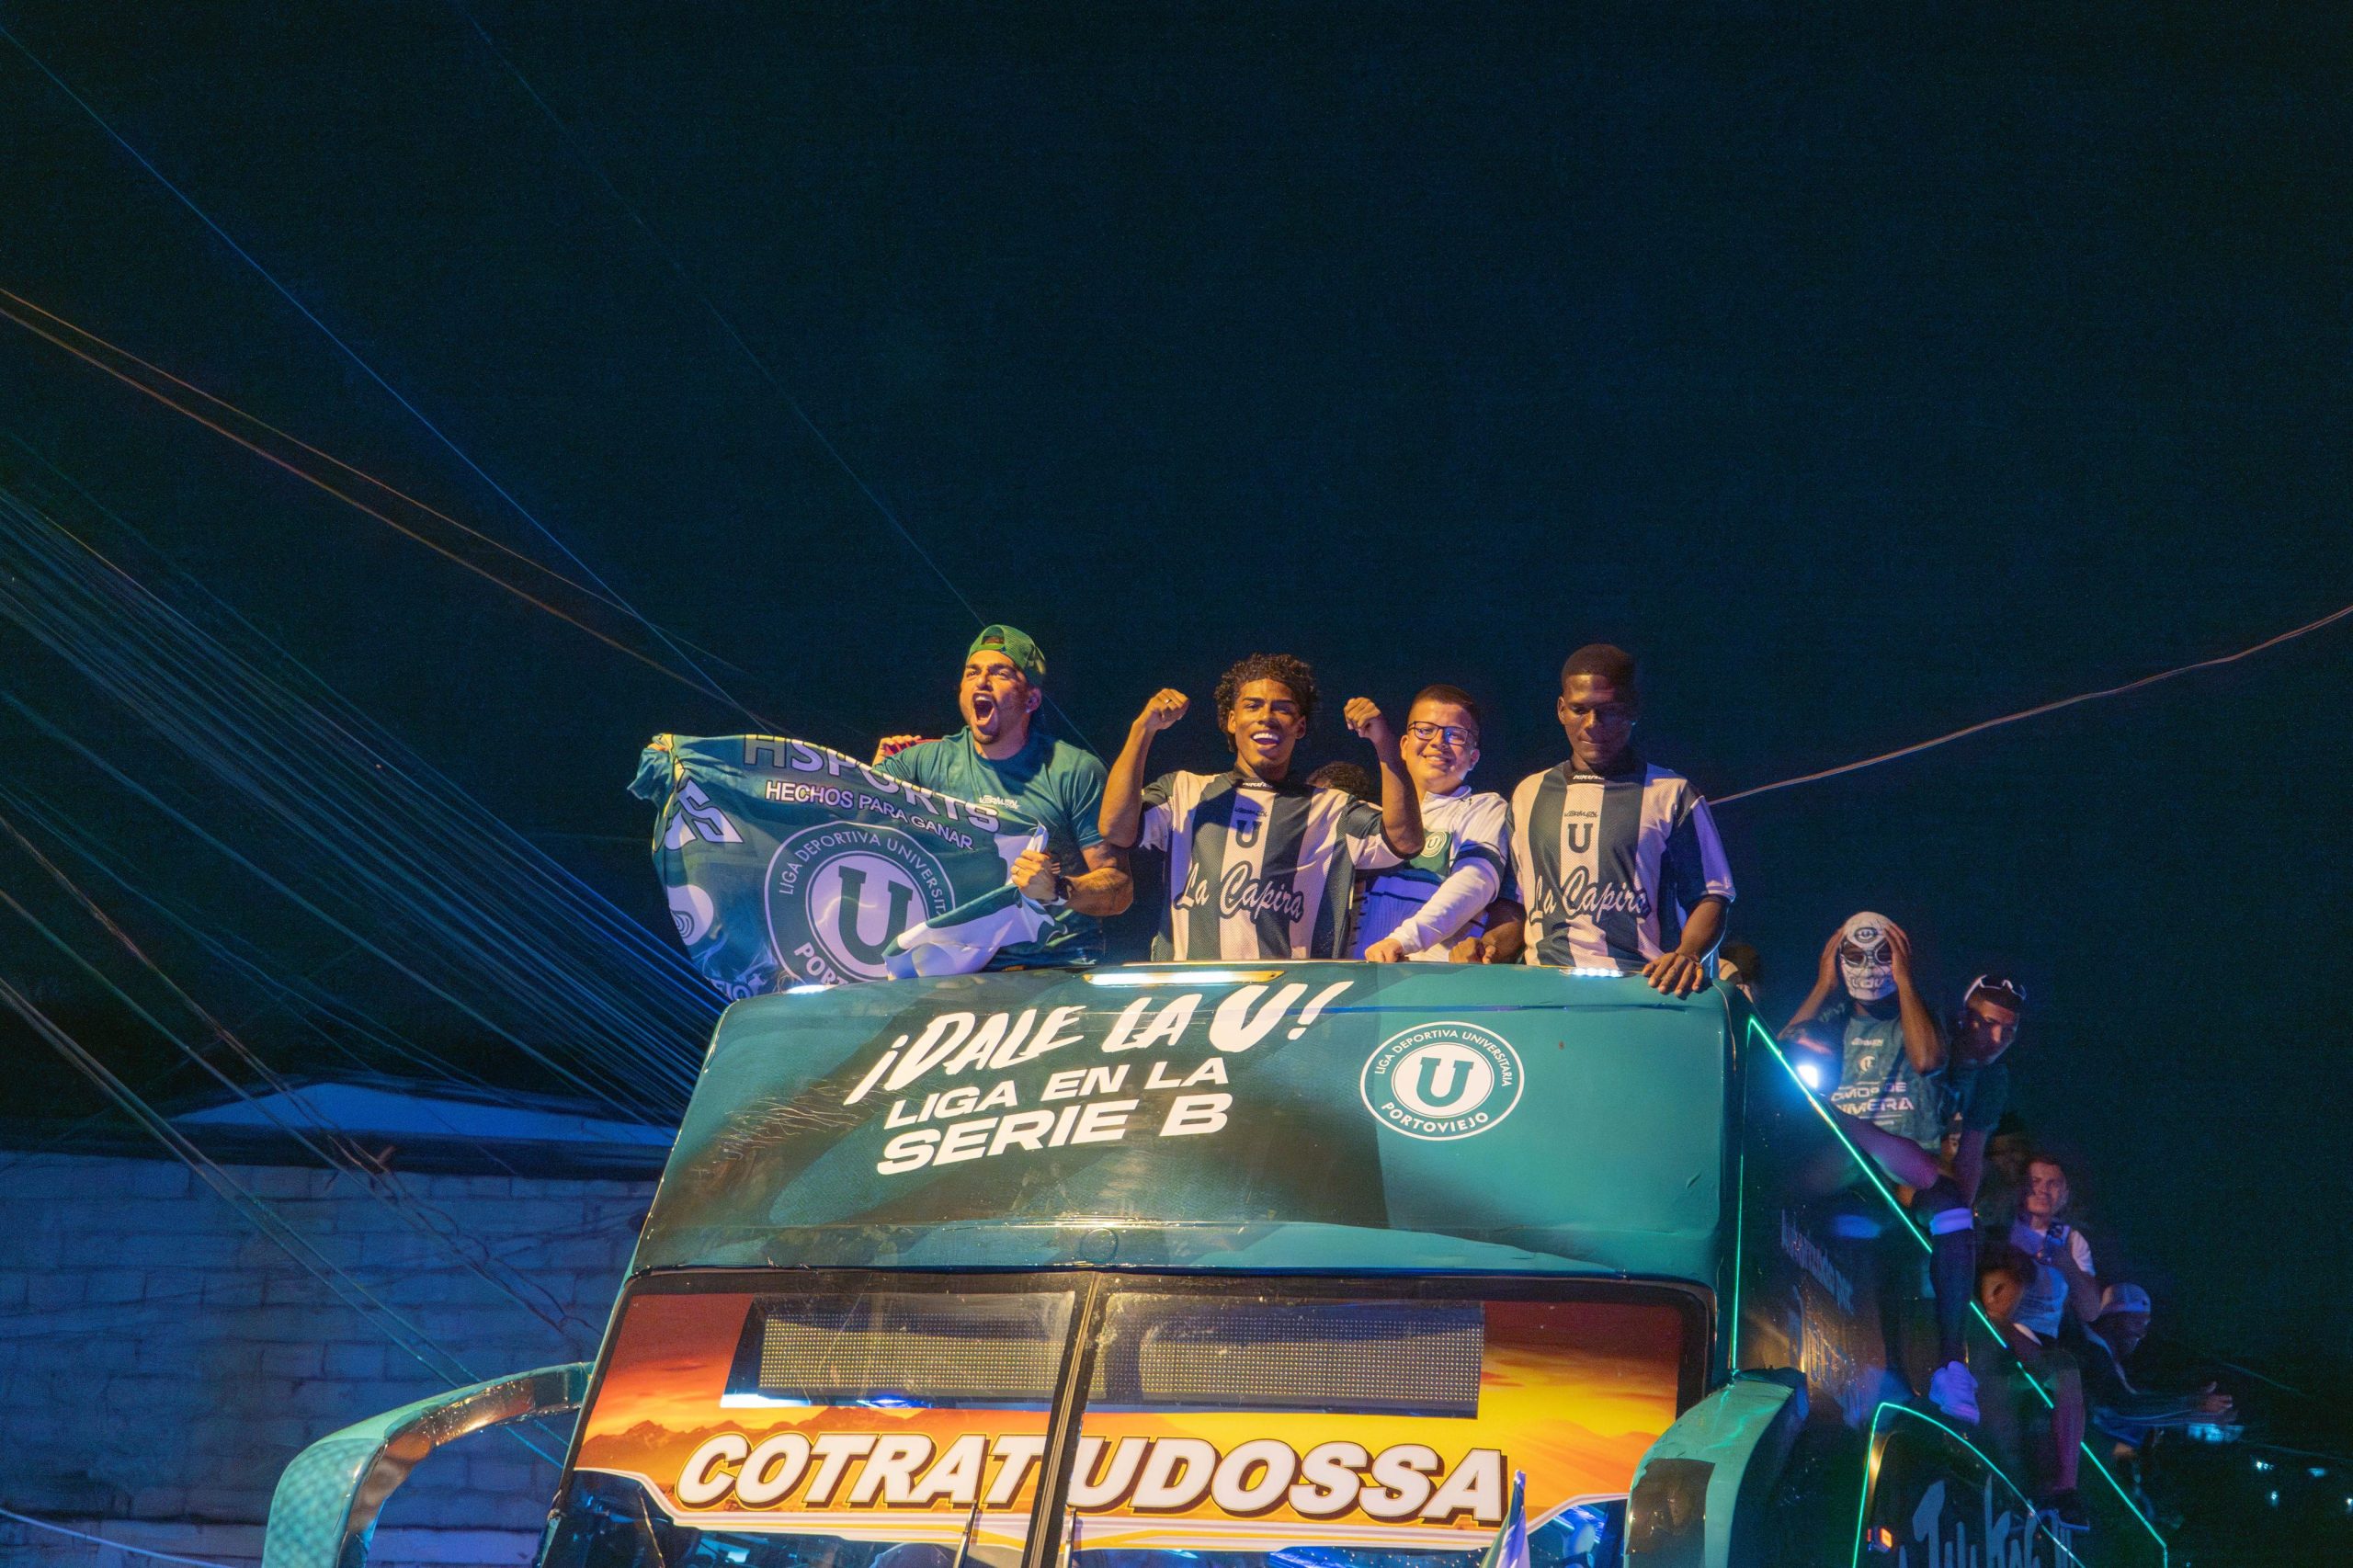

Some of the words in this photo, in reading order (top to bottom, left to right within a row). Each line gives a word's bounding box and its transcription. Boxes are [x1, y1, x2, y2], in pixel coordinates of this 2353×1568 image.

[765, 780, 855, 810] HECHOS
[858, 794, 908, 824] PARA
[911, 814, 974, 851] GANAR
[1235, 820, 1263, 848] U
[1568, 824, 1593, 853] U
[779, 861, 802, 895] LIGA
[795, 831, 881, 862] DEPORTIVA
[887, 837, 946, 915] UNIVERSIT
[1175, 861, 1210, 909] La
[1220, 860, 1304, 921] Capira
[1529, 875, 1557, 922] La
[838, 866, 913, 966] U
[843, 1006, 1086, 1106] ¡DALE
[1101, 994, 1203, 1052] LA
[1209, 981, 1354, 1052] U!
[1374, 1053, 1395, 1074] LIGA
[1392, 1029, 1458, 1053] DEPORTIVA
[1461, 1030, 1513, 1087] UNIVERSITARIA
[884, 1080, 1017, 1130] LIGA
[1040, 1064, 1131, 1101] EN
[1143, 1057, 1229, 1089] LA
[1416, 1057, 1474, 1108] U
[877, 1099, 1140, 1176] SERIE
[1159, 1093, 1233, 1136] B
[1381, 1101, 1489, 1133] PORTOVIEJO
[676, 1433, 1503, 1523] COTRATUDOSSA
